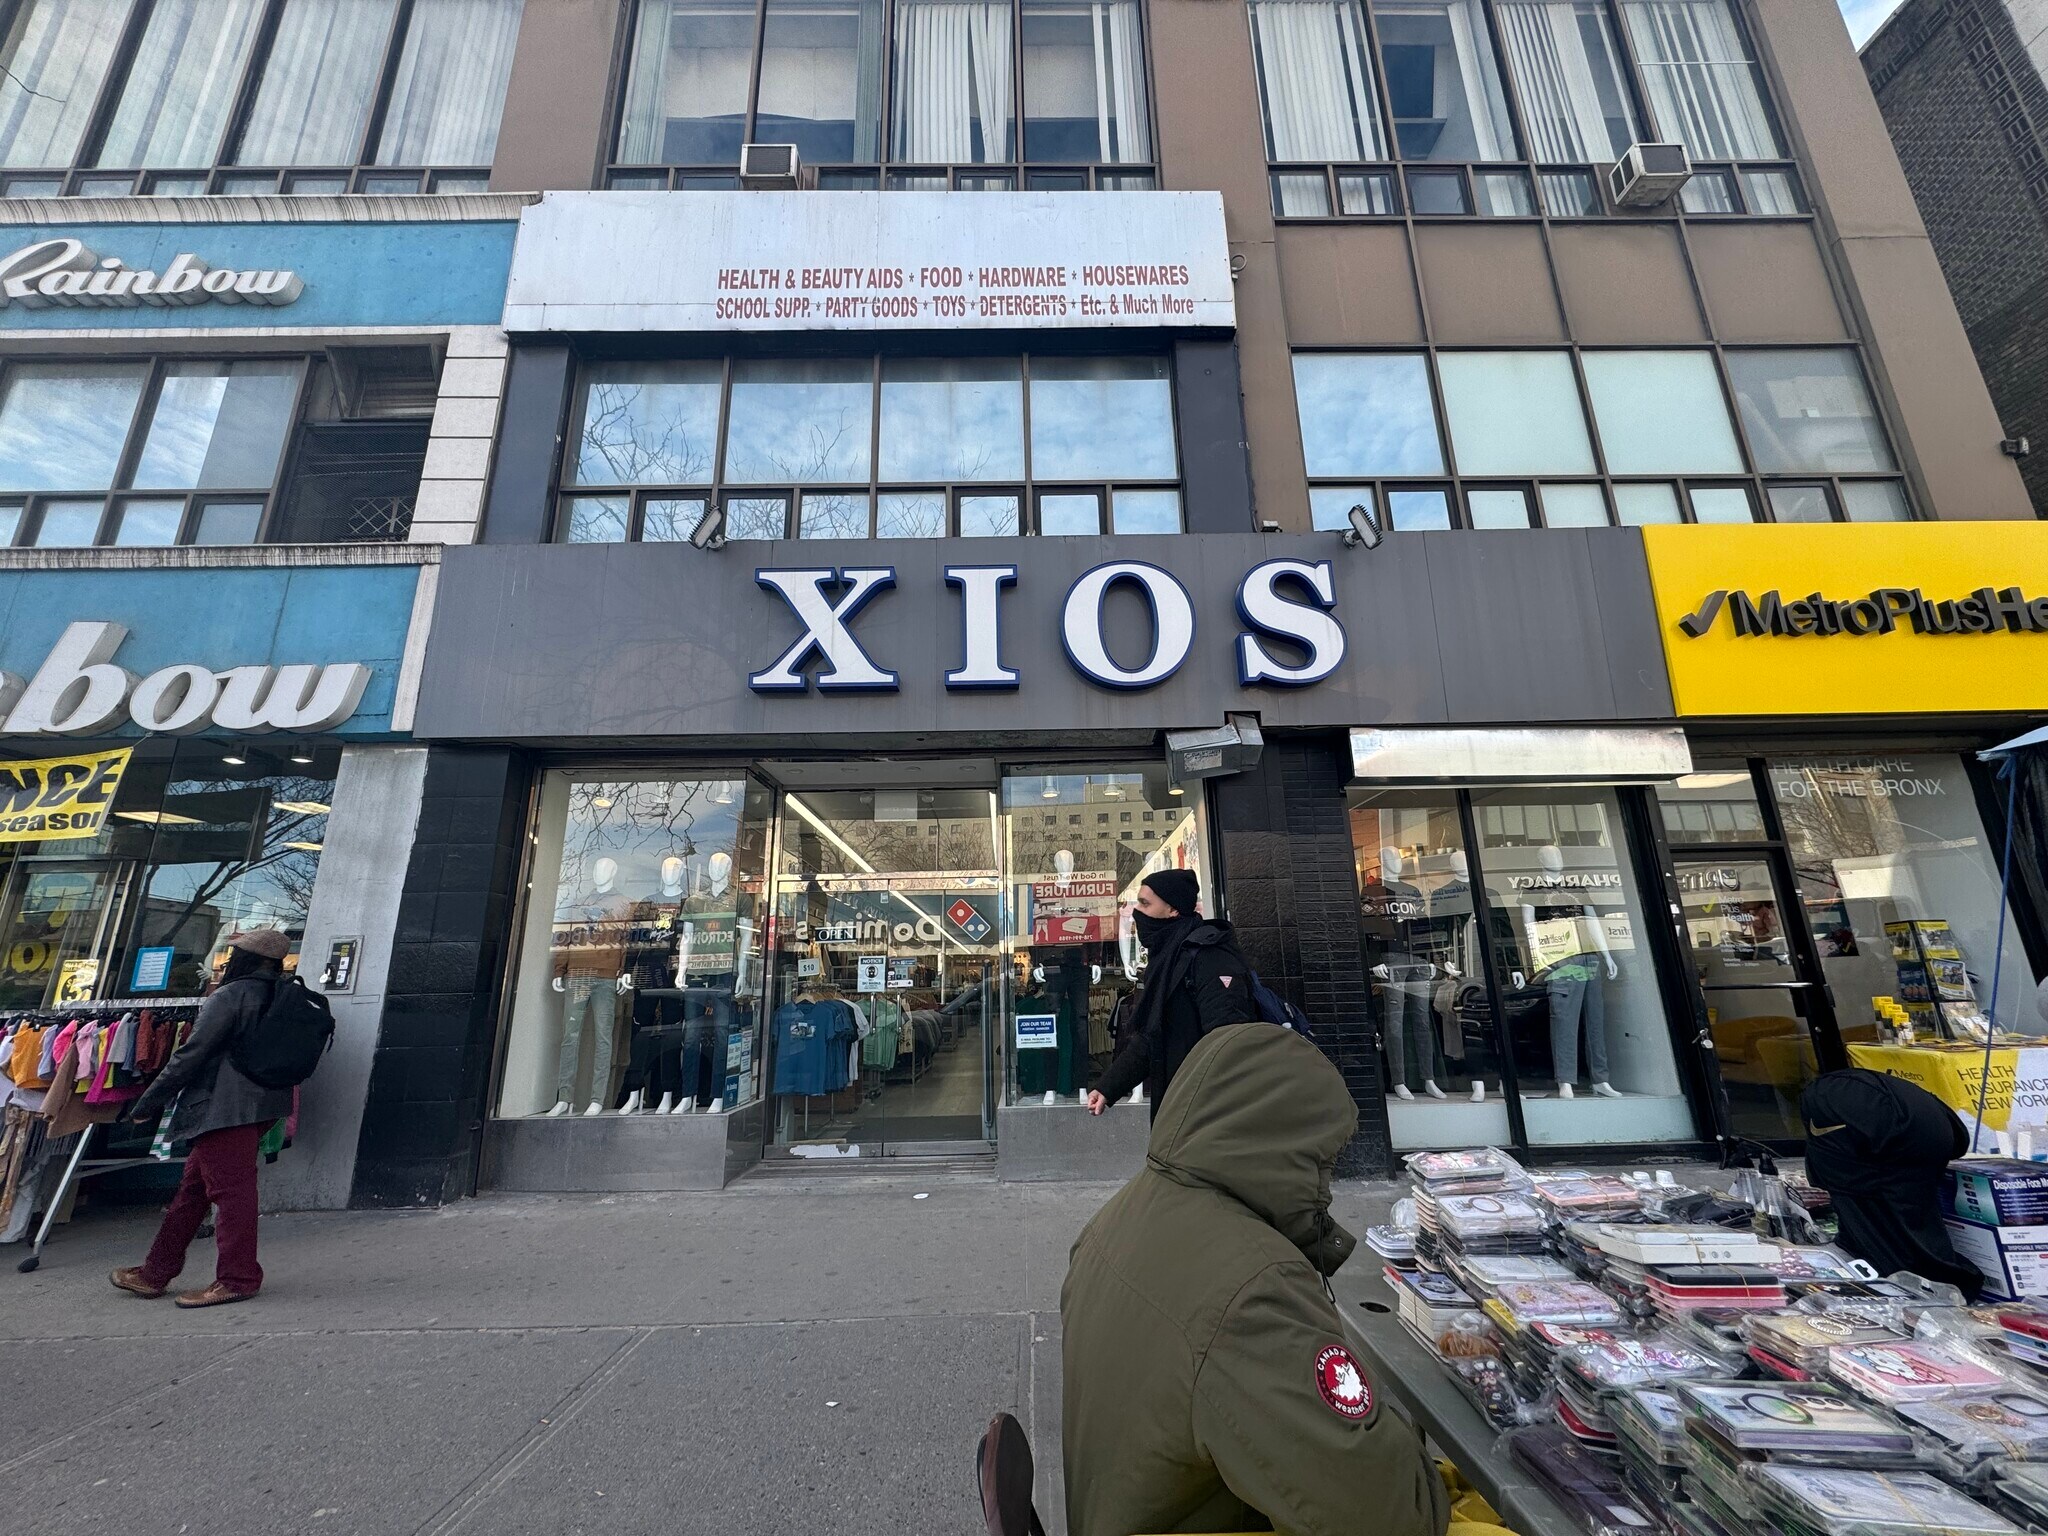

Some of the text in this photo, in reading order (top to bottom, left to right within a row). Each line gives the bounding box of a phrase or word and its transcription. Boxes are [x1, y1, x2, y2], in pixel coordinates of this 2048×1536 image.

[0, 238, 304, 308] Rainbow
[718, 265, 1189, 289] HEALTH & BEAUTY AIDS FOOD HARDWARE HOUSEWARES
[716, 294, 1194, 319] SCHOOL SUPP. PARTY GOODS TOYS DETERGENTS Etc. & Much More
[748, 559, 1348, 694] XIOS
[0, 620, 373, 735] bow
[1773, 758, 1914, 775] HEALTH CARE
[1778, 778, 1946, 798] FOR THE BRONX
[1718, 896, 1744, 904] Metro
[1720, 904, 1740, 914] Plus
[1722, 913, 1755, 922] Health
[818, 928, 854, 941] OPEN
[803, 963, 815, 972] $10
[1895, 1069, 1924, 1081] Metro
[1957, 1065, 2017, 1081] HEALTH
[1971, 1096, 2011, 1111] NEW
[1993, 1178, 2027, 1191] Disposable
[2026, 1177, 2041, 1188] Face
[1334, 1400, 1365, 1415] weather
